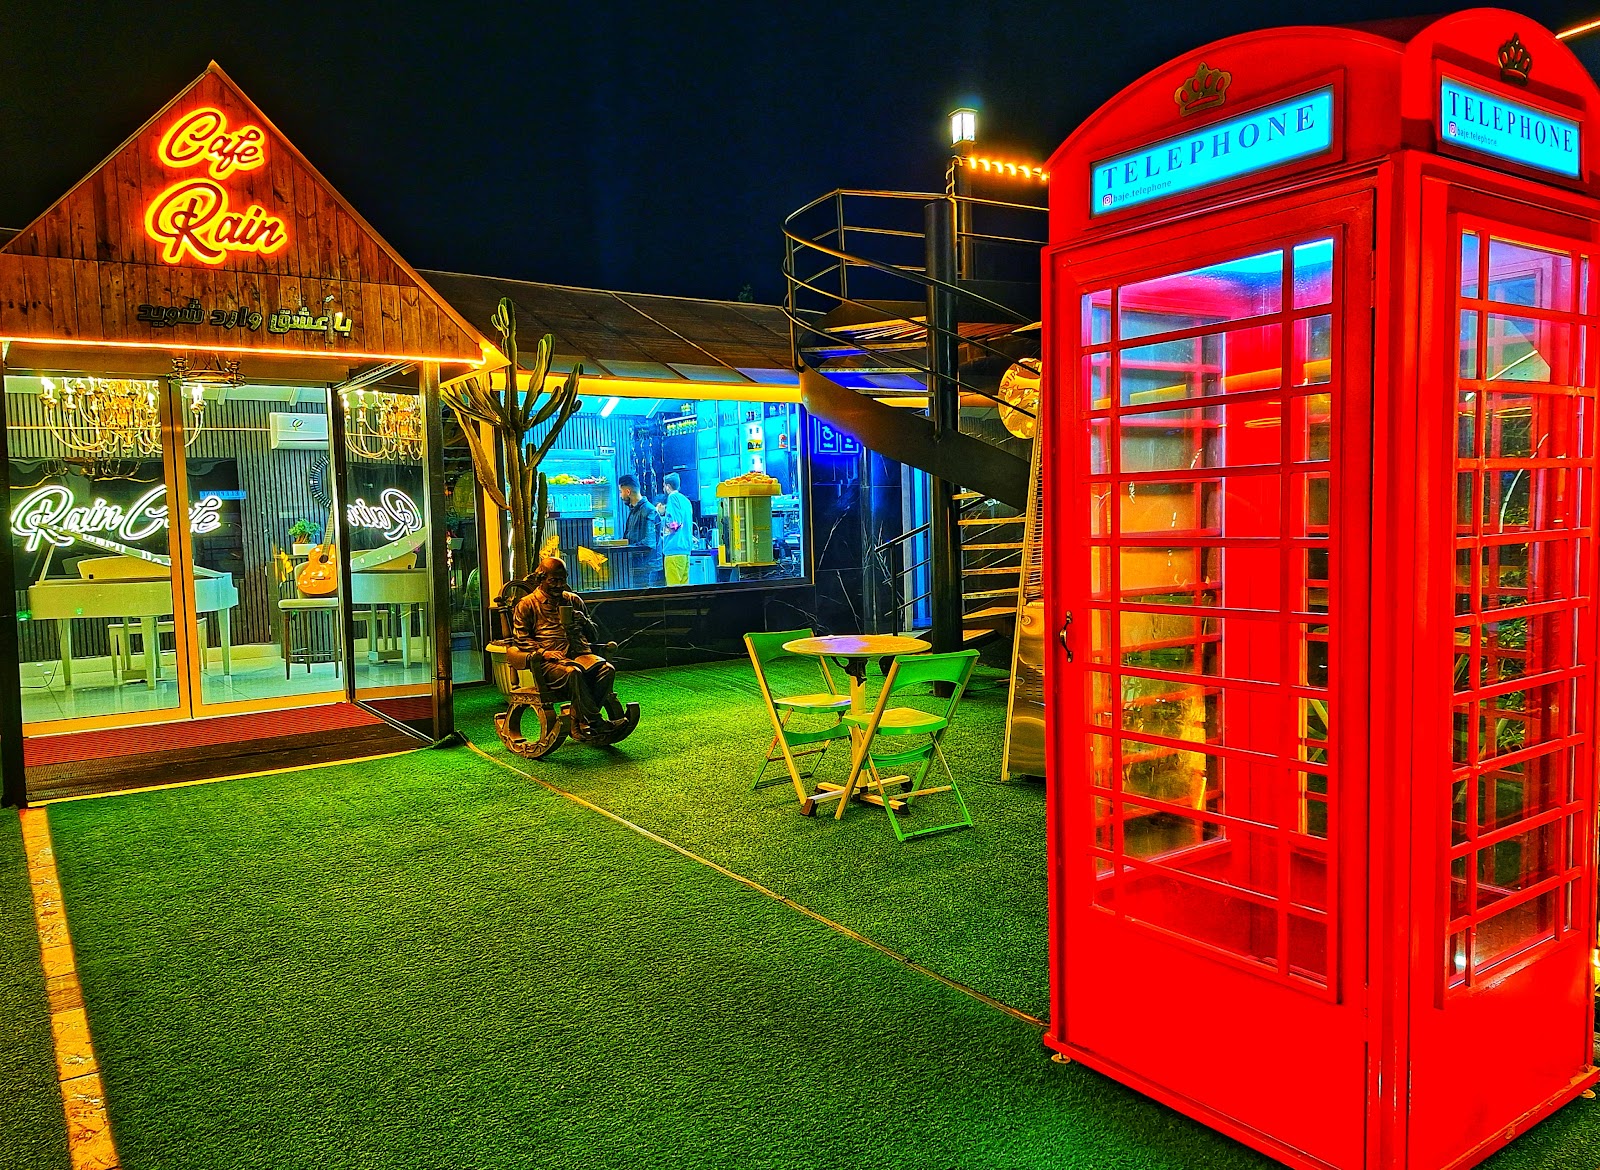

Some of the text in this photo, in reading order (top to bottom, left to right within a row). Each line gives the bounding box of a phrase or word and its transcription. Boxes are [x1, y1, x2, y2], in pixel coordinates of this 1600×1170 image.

[1448, 90, 1573, 153] TELEPHONE
[1102, 104, 1315, 190] TELEPHONE
[1113, 179, 1173, 204] baje.telephone
[147, 180, 287, 262] Rain
[137, 299, 205, 328] شوید
[210, 306, 263, 331] وارد
[268, 305, 328, 334] عشق
[11, 484, 223, 552] Rain Cfe
